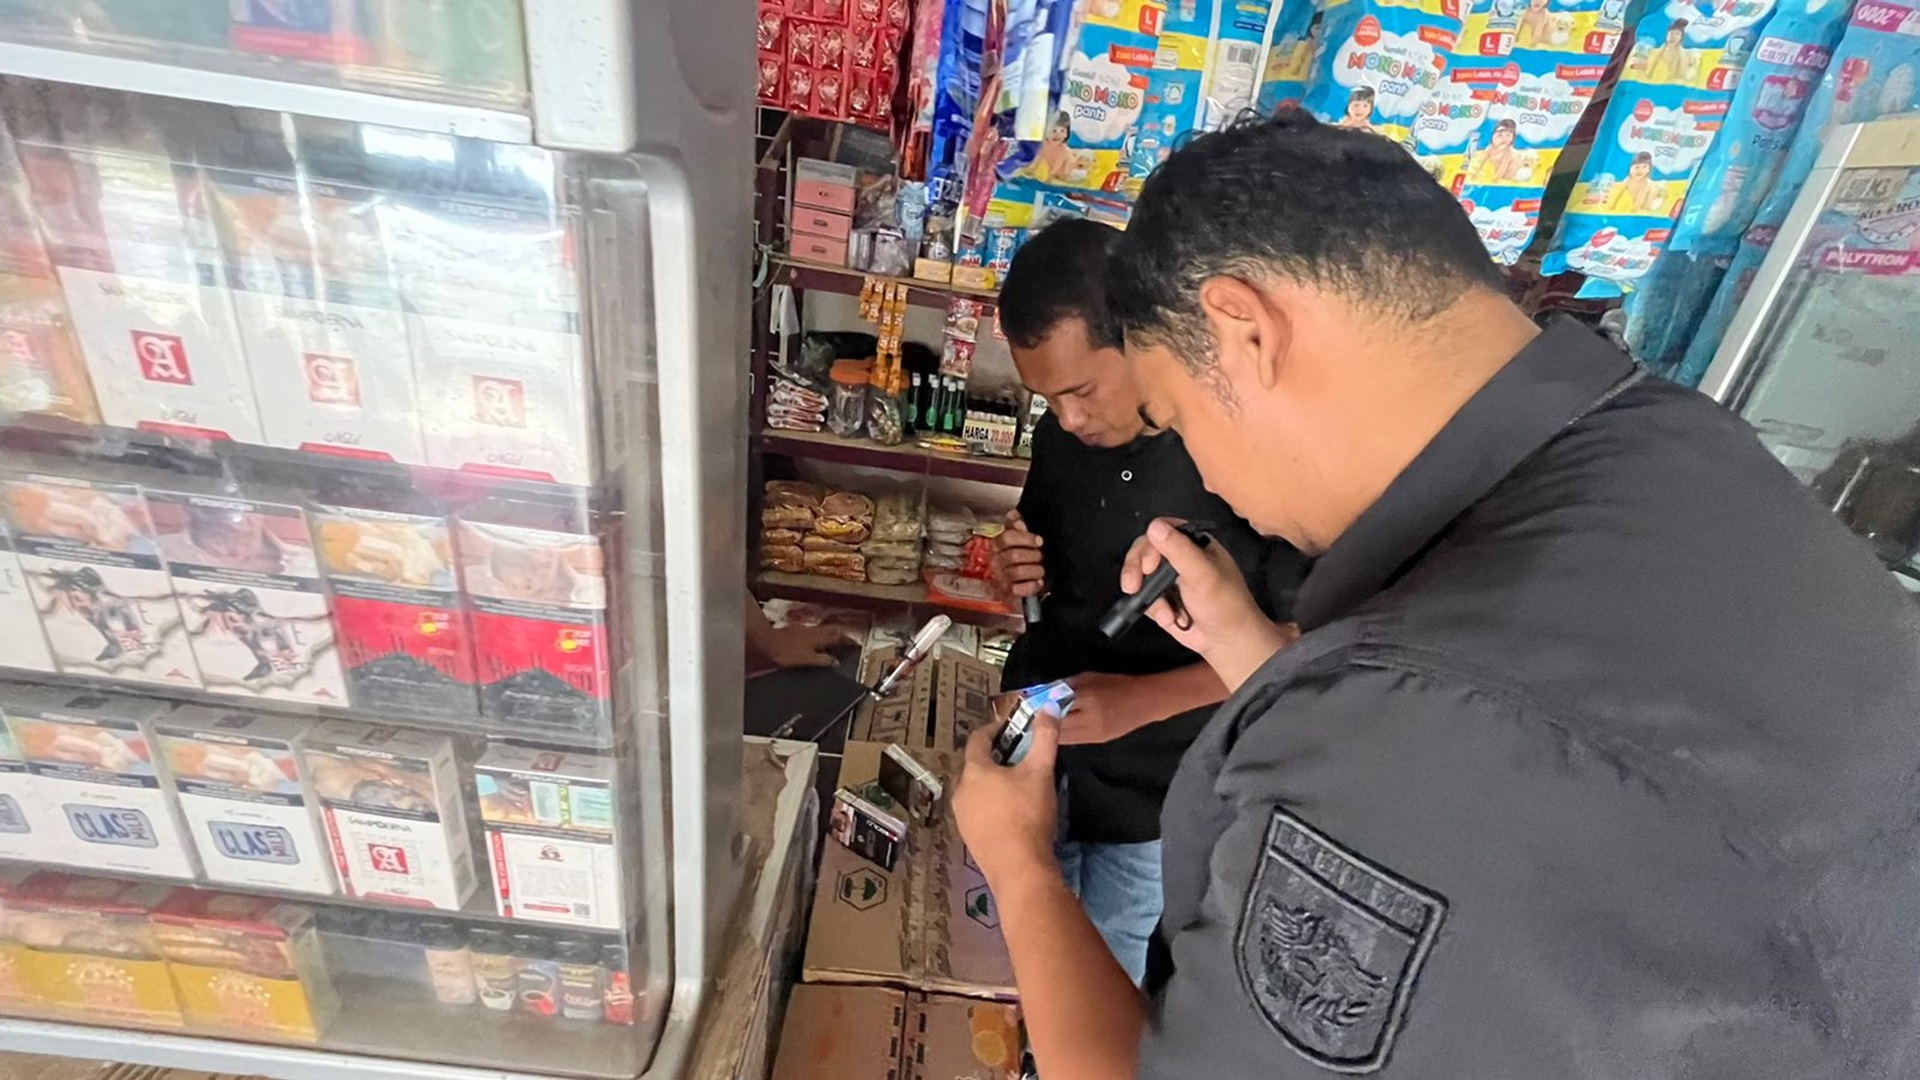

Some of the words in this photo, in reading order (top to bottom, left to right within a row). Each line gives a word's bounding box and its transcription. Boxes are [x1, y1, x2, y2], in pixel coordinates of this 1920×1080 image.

[1094, 85, 1139, 110] MOKO
[1074, 104, 1107, 122] pants
[965, 425, 990, 440] HARGA
[74, 811, 130, 839] CLAS
[218, 829, 272, 855] CLAS
